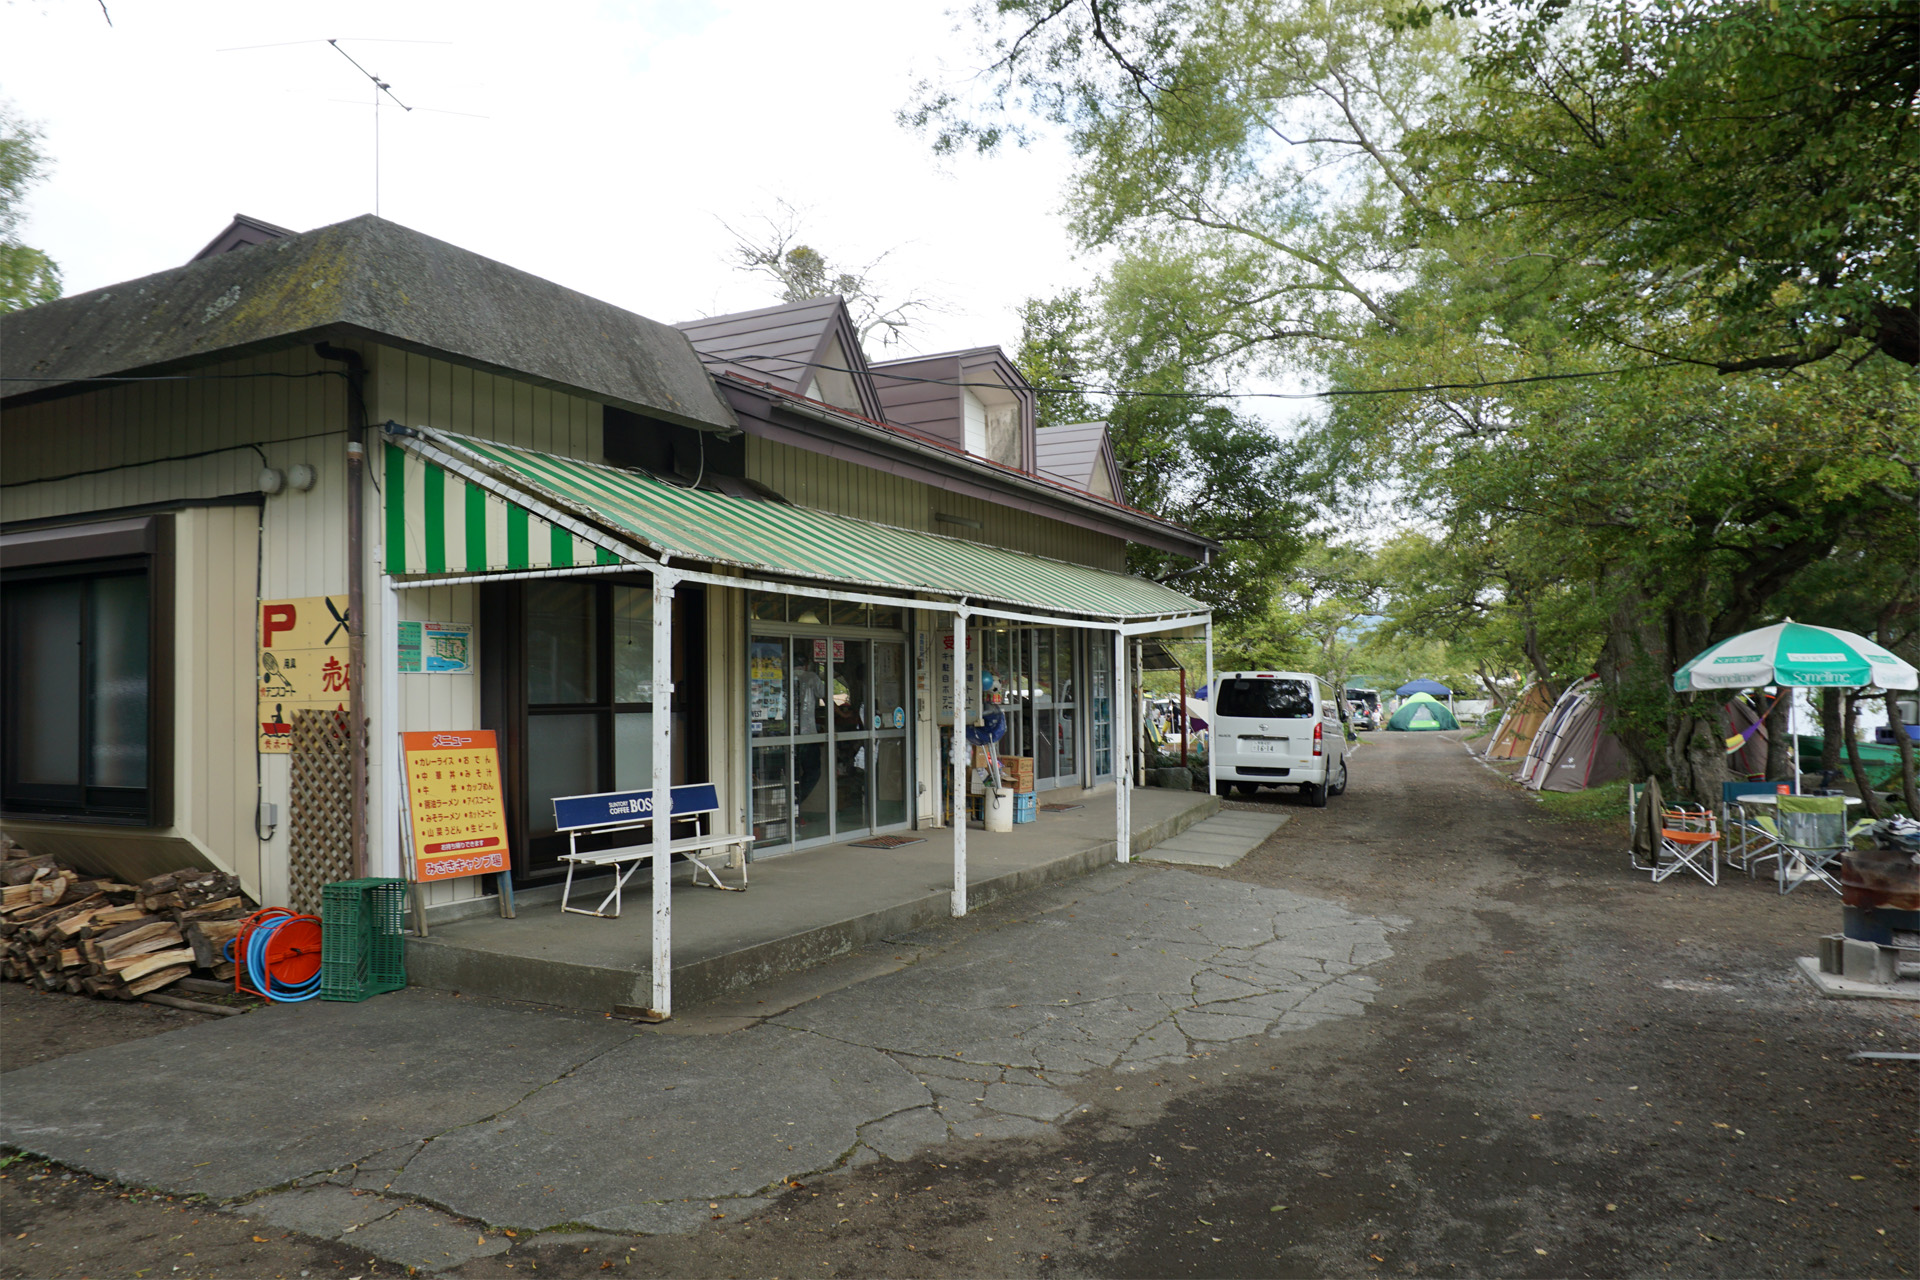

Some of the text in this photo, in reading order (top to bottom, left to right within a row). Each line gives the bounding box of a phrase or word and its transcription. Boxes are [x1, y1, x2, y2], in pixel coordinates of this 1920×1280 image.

[263, 604, 296, 648] P
[432, 734, 471, 748] メニュー
[419, 757, 454, 767] カレーライス
[463, 755, 491, 765] おでん
[464, 769, 492, 778] みそ汁
[466, 782, 493, 792] カップめん
[467, 796, 495, 806] アイスコーヒー
[609, 797, 653, 815] COFFEE BOS
[425, 812, 461, 823] みそラーメン
[469, 810, 496, 819] ホットコーヒー
[427, 826, 462, 837] 山菜うどん
[470, 822, 498, 833] 生ビール
[440, 840, 484, 851] お持ち帰りできます
[425, 854, 502, 876] みさきキャンプ場
